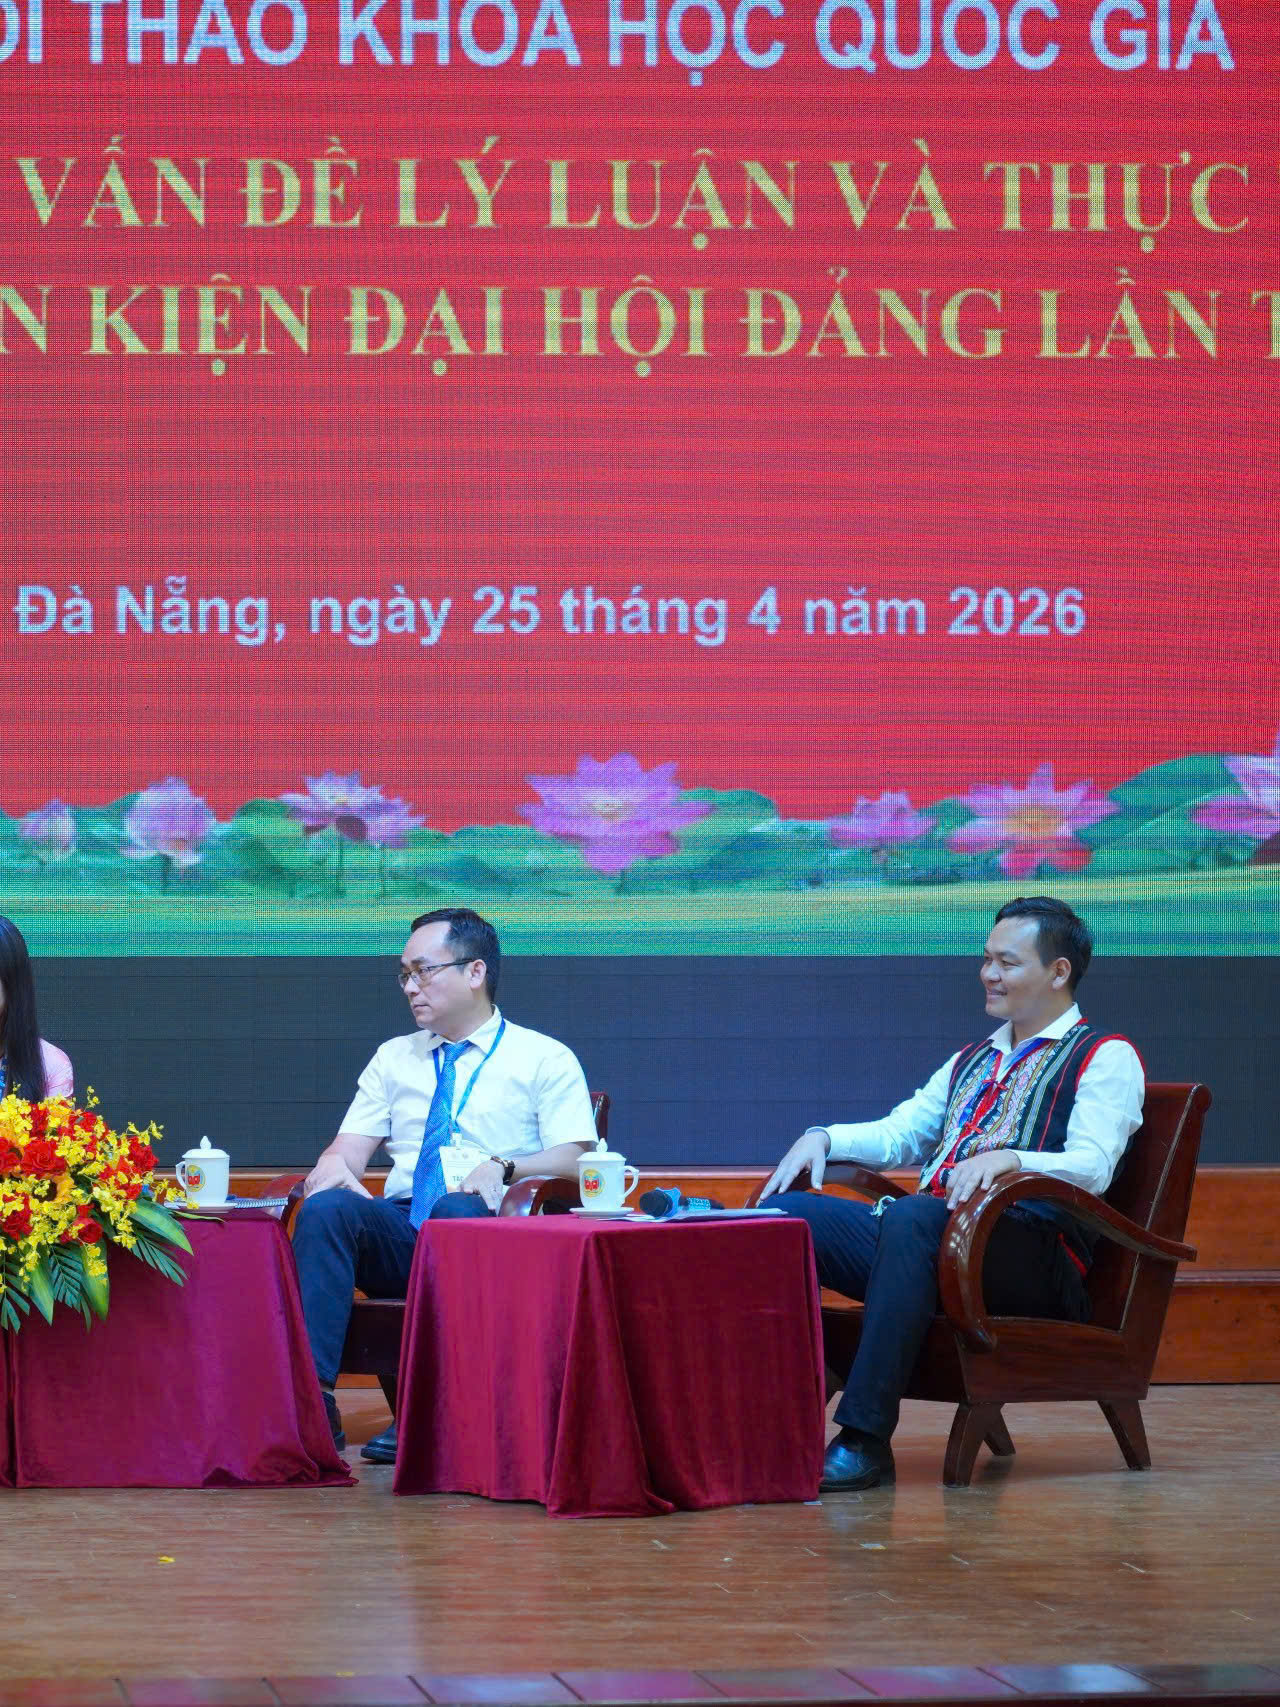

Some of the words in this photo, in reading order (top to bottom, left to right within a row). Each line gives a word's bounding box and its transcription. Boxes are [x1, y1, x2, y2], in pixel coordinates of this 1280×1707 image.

[338, 0, 583, 68] KHOA
[607, 0, 787, 88] HỌC
[1089, 0, 1237, 72] GIA
[14, 135, 210, 229] VẤN
[239, 136, 365, 230] ĐỀ
[395, 136, 517, 230] LÝ
[546, 148, 800, 252] LUẬN
[828, 138, 956, 232] VÀ
[983, 150, 1251, 254] THỰC
[84, 272, 315, 377] KIỆN
[342, 286, 509, 378] ĐẠI
[538, 274, 712, 379] HỘI
[739, 266, 1007, 360] ĐẢNG
[1037, 267, 1221, 360] LẦN
[12, 585, 95, 635] Đà
[115, 575, 288, 648] Nẵng,
[309, 584, 454, 648] ngày
[472, 585, 543, 636] 25
[558, 585, 730, 648] tháng
[747, 587, 784, 636] 4
[803, 587, 929, 637] năm
[947, 587, 1088, 637] 2026
